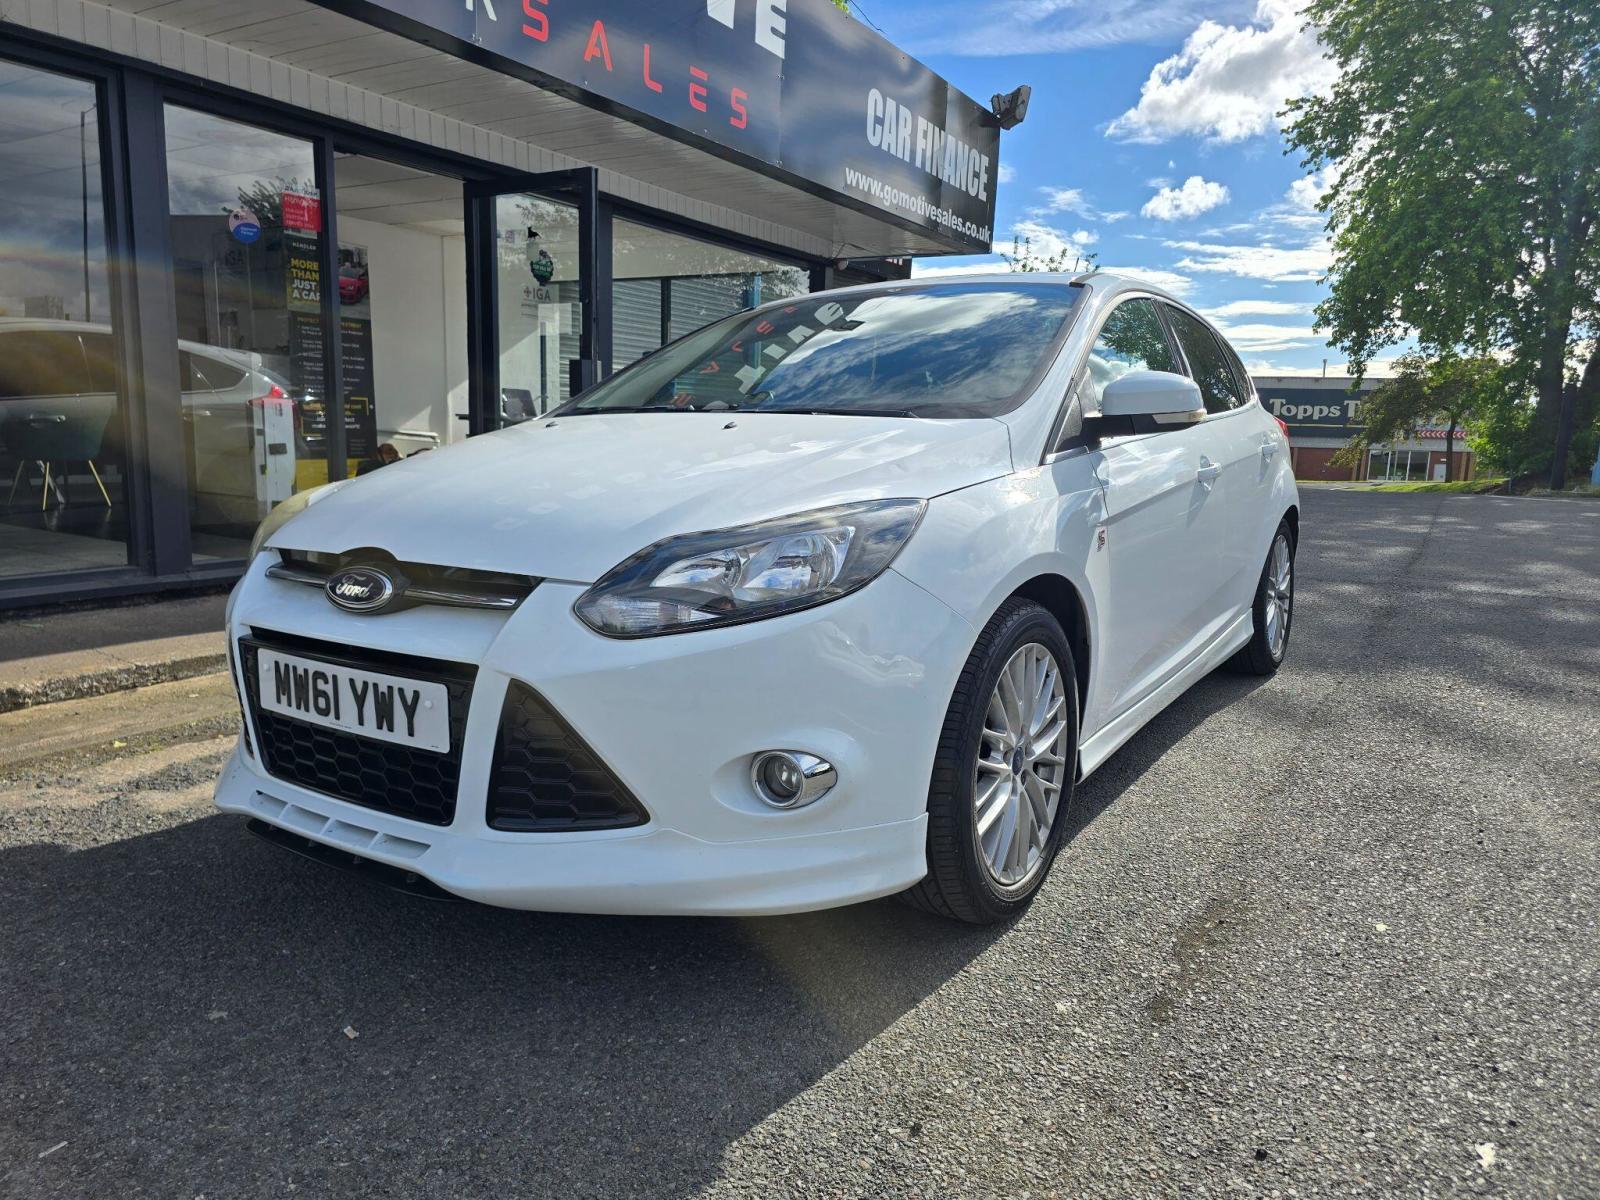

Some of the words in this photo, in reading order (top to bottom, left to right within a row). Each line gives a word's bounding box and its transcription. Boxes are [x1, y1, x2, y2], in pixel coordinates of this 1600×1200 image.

[522, 0, 748, 129] SALES
[866, 88, 912, 163] CAR
[916, 116, 990, 202] FINANCE
[845, 167, 991, 244] www.gomotivesales.co.uk
[291, 258, 320, 270] MORE
[291, 269, 320, 281] THAN
[292, 279, 317, 290] JUST
[292, 289, 301, 299] A
[532, 288, 551, 300] IGA
[1269, 398, 1342, 420] Topps
[335, 574, 373, 598] Ford
[274, 660, 341, 721] MW61
[349, 677, 420, 738] YWY
